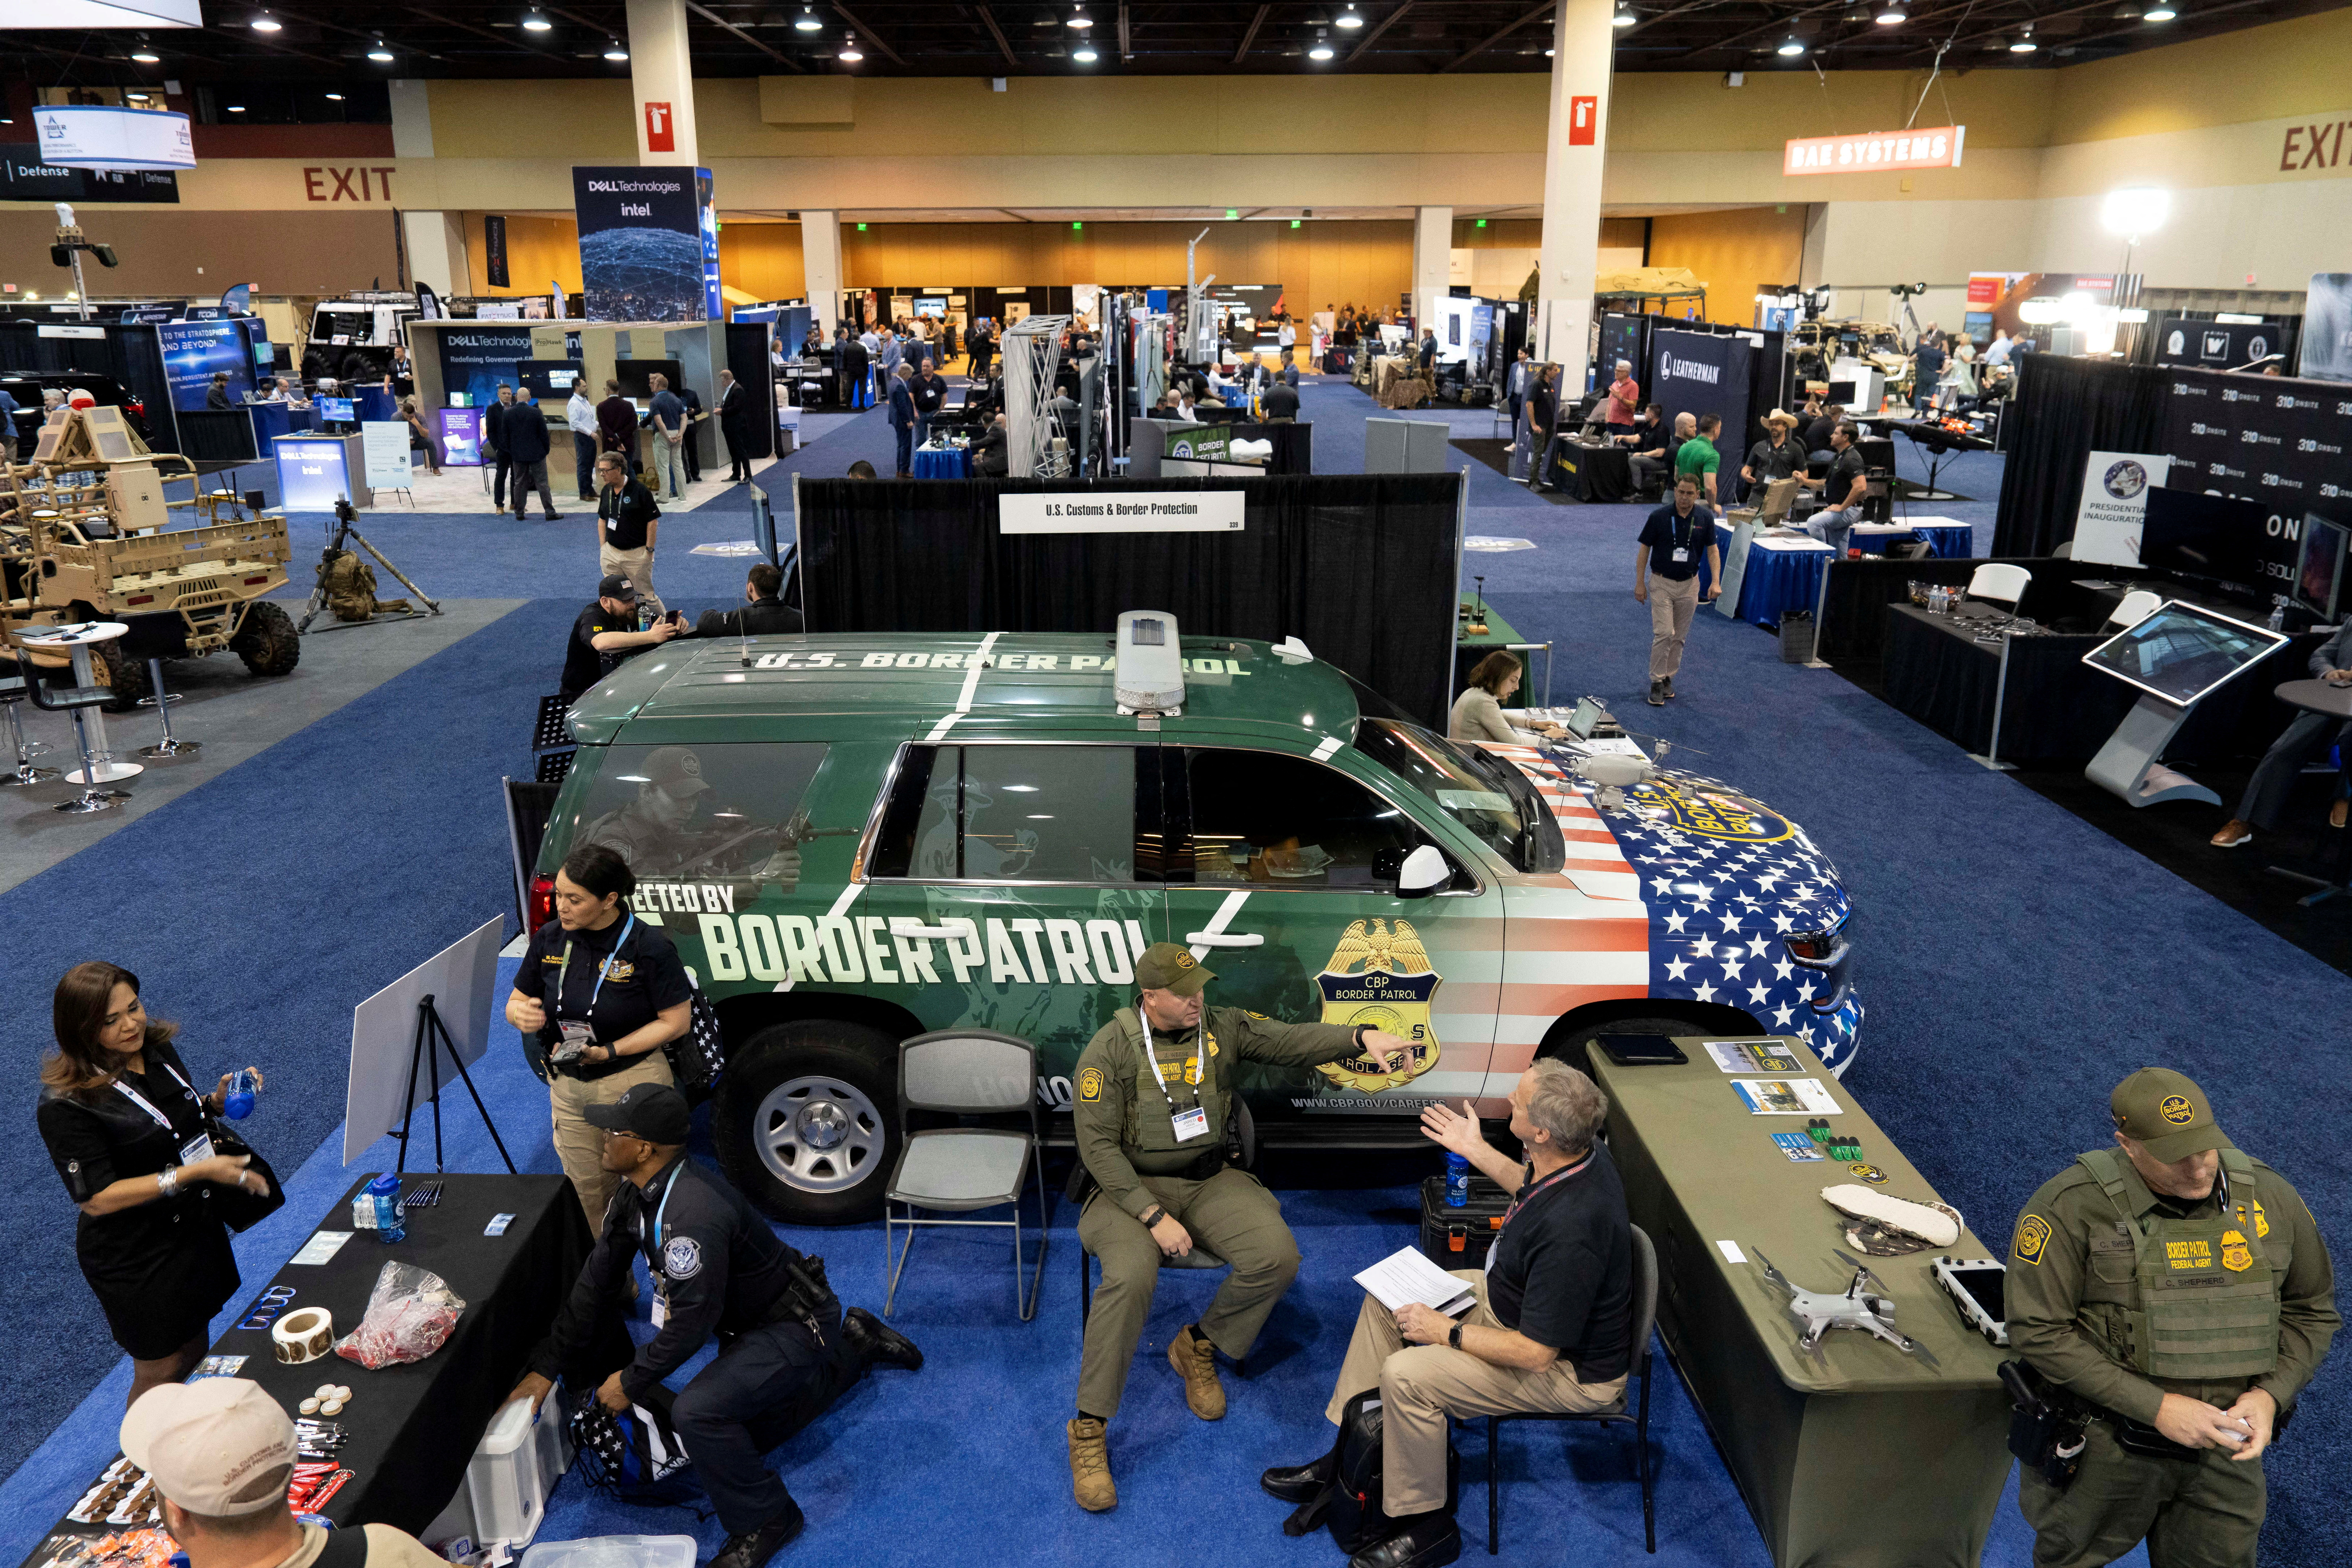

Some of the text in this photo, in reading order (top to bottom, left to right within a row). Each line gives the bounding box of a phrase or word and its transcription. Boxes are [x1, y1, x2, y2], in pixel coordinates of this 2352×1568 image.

[1792, 135, 1947, 168] BAE SYSTEMS
[2280, 121, 2352, 171] EXI
[19, 166, 69, 177] Defense
[304, 168, 395, 201] EXIT
[589, 181, 680, 194] DELL Technologies
[174, 331, 186, 339] THE
[448, 335, 532, 348] DELL Technologi
[1672, 358, 1718, 384] LEATHERMAN
[2173, 383, 2187, 395] 310
[2222, 388, 2238, 401] 310
[2276, 395, 2295, 409] 310
[2191, 422, 2206, 435] 310
[2241, 430, 2258, 444] 310
[1198, 440, 1224, 452] BORDER
[2298, 439, 2317, 452] 310
[2209, 462, 2226, 476] 310
[2262, 472, 2279, 486] 310
[2320, 483, 2339, 498] 310
[1046, 503, 1198, 516] U.S. Customs & Border Protection
[2090, 502, 2146, 514] PRESIDENTIA
[2084, 512, 2145, 524] INAUGURATIO
[755, 652, 847, 668] U.S.
[860, 653, 1058, 670] BORDER
[1633, 790, 1671, 810] U.S.
[702, 885, 735, 914] BY
[697, 913, 942, 983] BORDER
[1365, 977, 1389, 988] CBP
[1336, 990, 1417, 999] BORDER PATROL
[1169, 1062, 1182, 1074] PATROL
[2165, 1104, 2188, 1113] BORDER
[2169, 1110, 2192, 1120] PATROL
[192, 1148, 206, 1158] NORMA
[2031, 1218, 2043, 1230] CUSTOMS
[2030, 1223, 2046, 1239] PROTECTION
[2166, 1241, 2212, 1259] BORDER PATROL
[2171, 1258, 2212, 1269] FEDERAL AGENT
[2178, 1277, 2225, 1286] SHEPHERD
